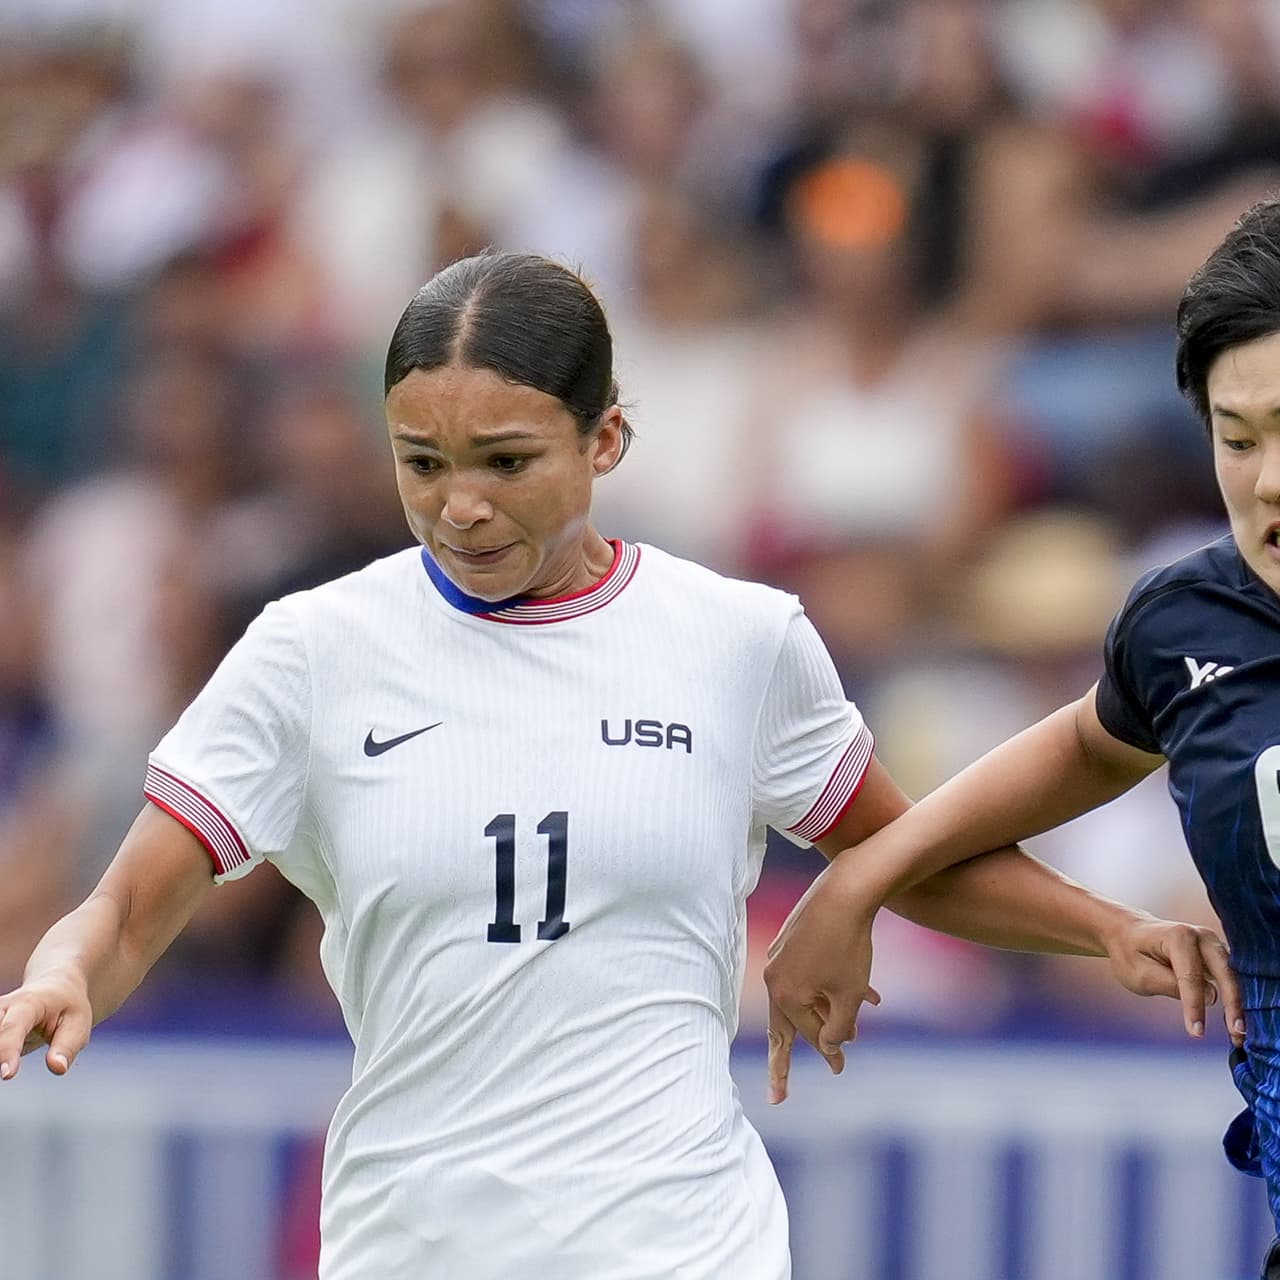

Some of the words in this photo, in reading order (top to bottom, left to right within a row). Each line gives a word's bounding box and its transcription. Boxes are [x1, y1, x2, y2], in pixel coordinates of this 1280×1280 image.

[1184, 656, 1234, 690] Y-
[601, 719, 692, 754] USA
[484, 811, 570, 944] 11
